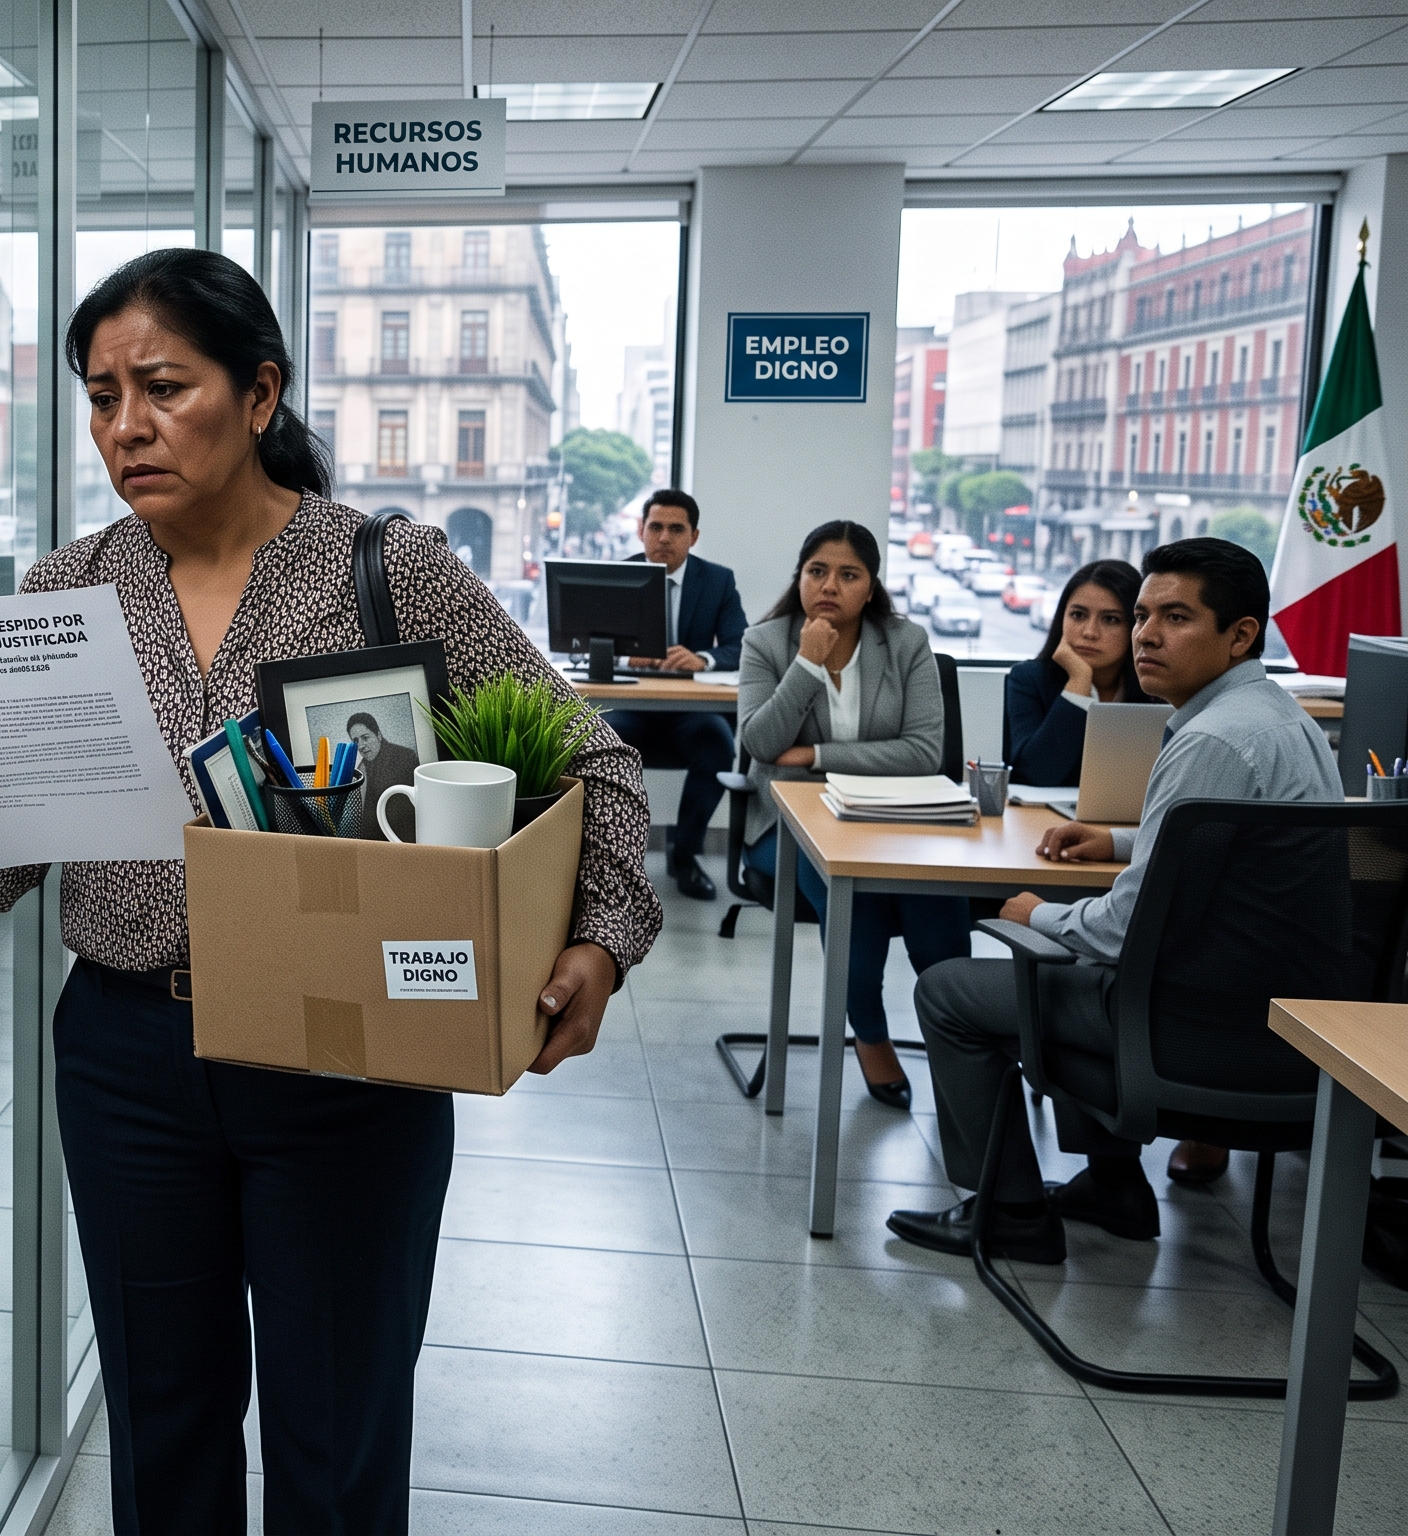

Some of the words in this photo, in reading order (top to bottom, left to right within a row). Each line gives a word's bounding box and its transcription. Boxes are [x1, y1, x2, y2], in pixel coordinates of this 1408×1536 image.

[334, 120, 482, 144] RECURSOS
[336, 151, 479, 174] HUMANOS
[745, 336, 850, 355] EMPLEO
[755, 360, 839, 380] DIGNO
[52, 613, 85, 628] POR
[389, 951, 468, 965] TRABAJO
[403, 969, 458, 982] DIGNO
